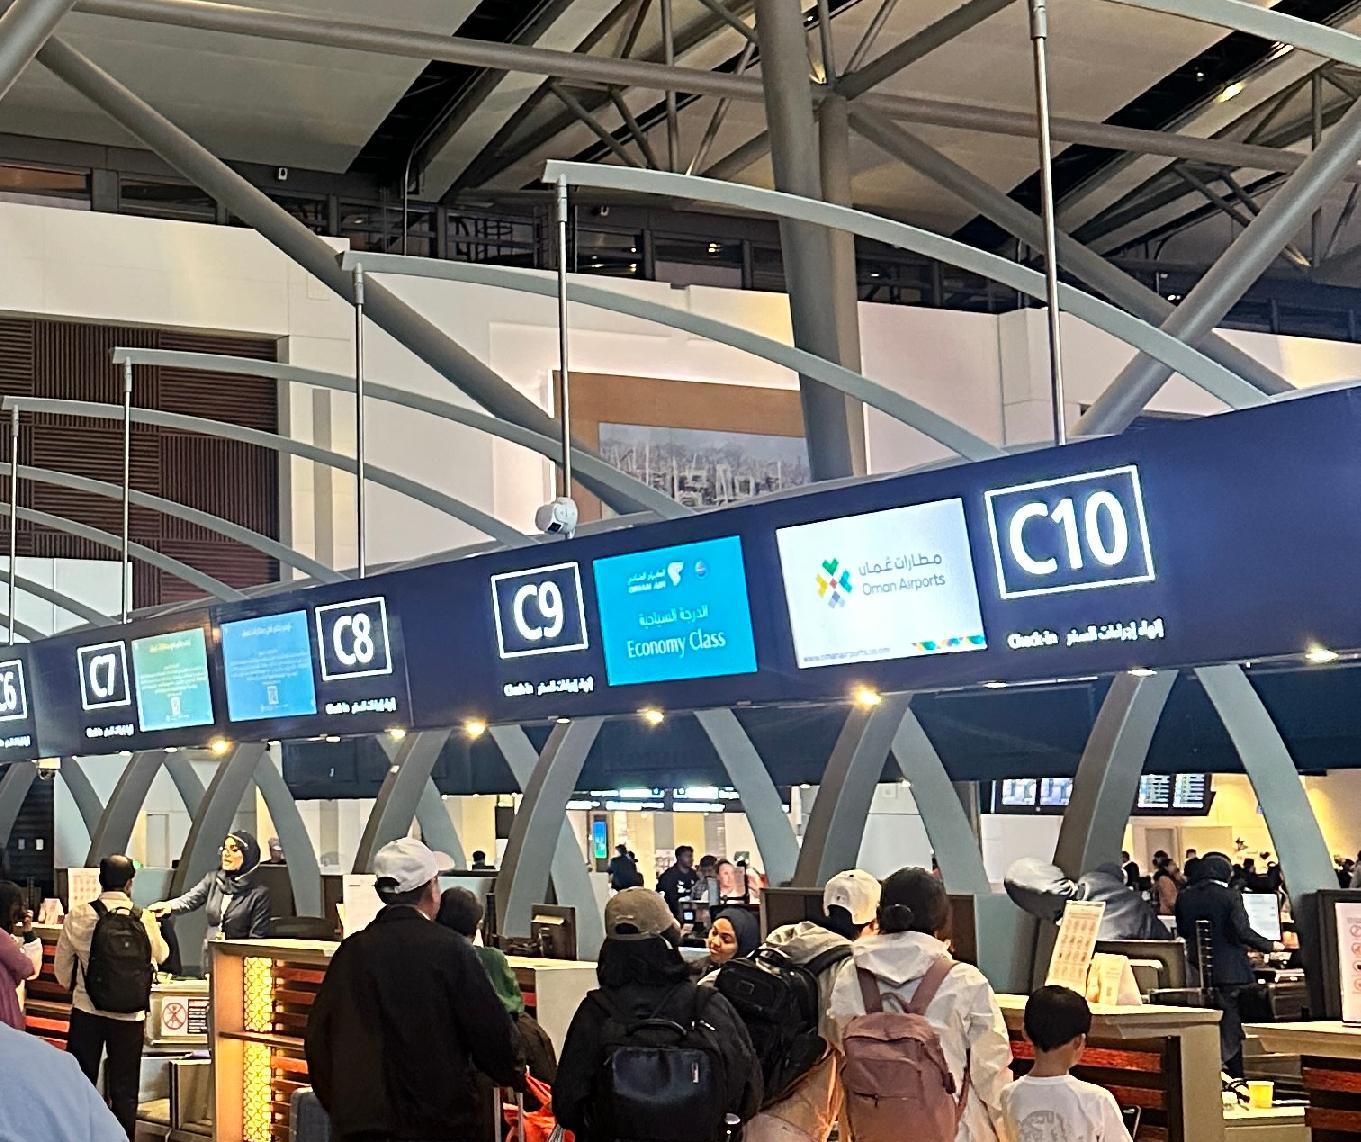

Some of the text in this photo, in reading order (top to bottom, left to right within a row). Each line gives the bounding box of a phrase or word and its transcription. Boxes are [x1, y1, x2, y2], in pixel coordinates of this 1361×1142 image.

[1009, 490, 1129, 575] C10
[862, 573, 946, 596] Oman Airports
[513, 581, 564, 640] C9
[333, 613, 374, 665] C8
[627, 628, 727, 658] Economy Class
[90, 653, 116, 698] C7
